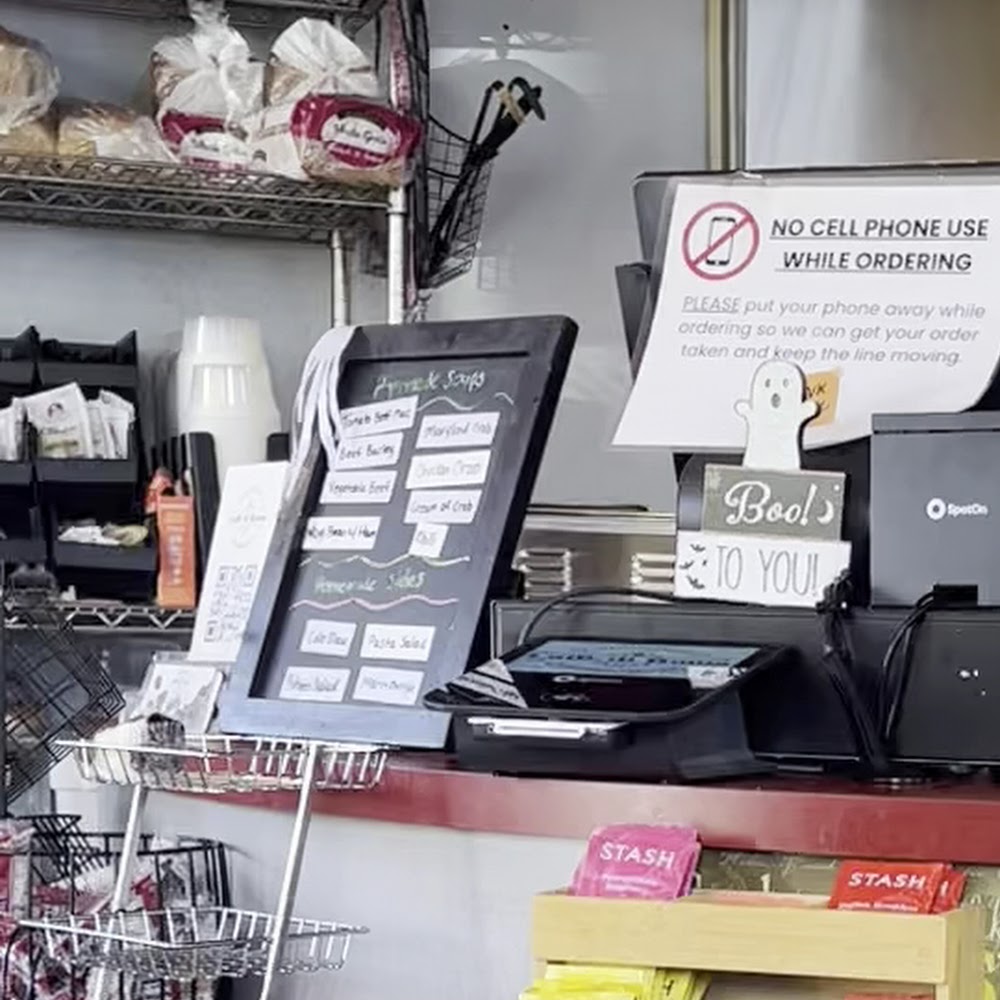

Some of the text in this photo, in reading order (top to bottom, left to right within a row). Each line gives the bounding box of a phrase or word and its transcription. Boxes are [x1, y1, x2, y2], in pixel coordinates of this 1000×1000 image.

[771, 219, 989, 237] NO CELL PHONE USE
[783, 252, 972, 271] WHILE ORDERING
[682, 295, 986, 320] PLEASE put your phone away while
[678, 320, 980, 343] ordering so we can get your order
[681, 344, 962, 367] taken and keep the line moving.
[724, 479, 818, 527] Boo!
[947, 502, 989, 518] SpotOn
[716, 545, 820, 598] TO YOU!
[600, 840, 676, 870] STASH
[847, 871, 928, 889] STASH
